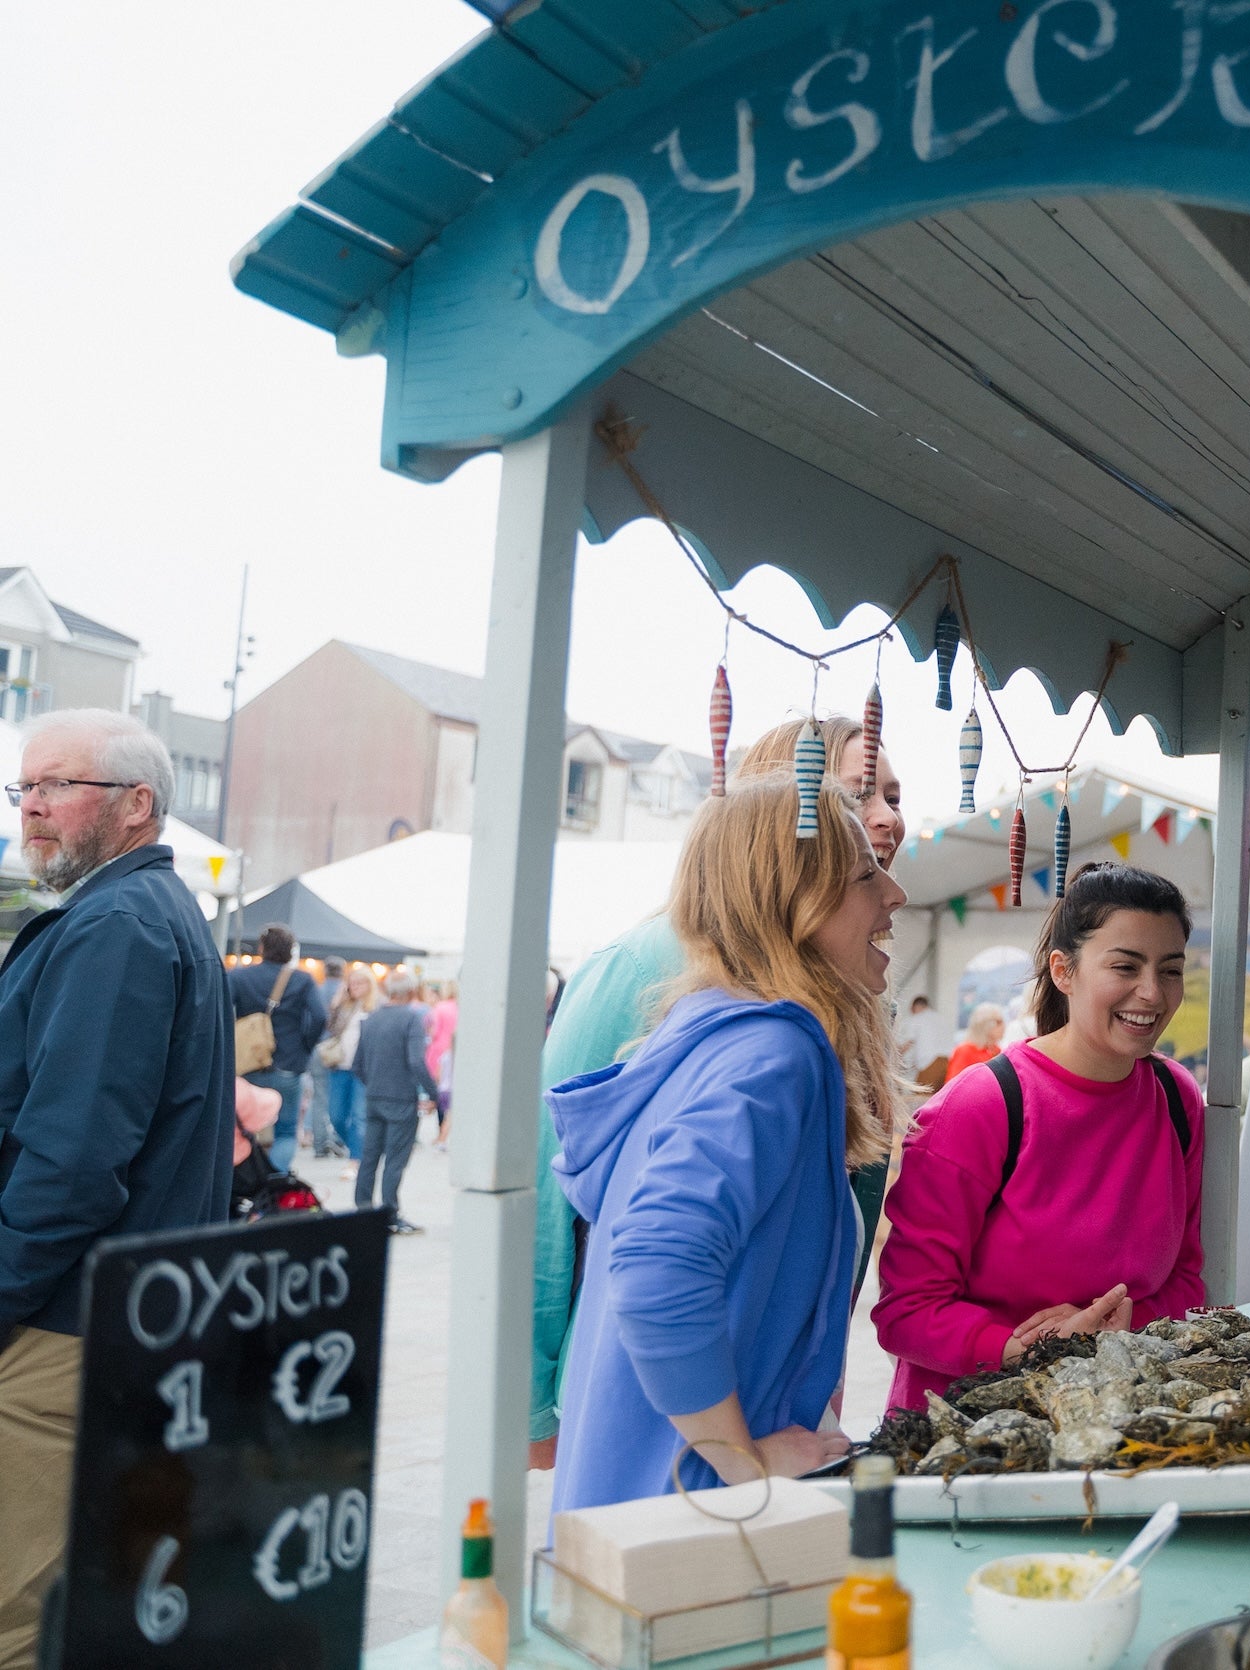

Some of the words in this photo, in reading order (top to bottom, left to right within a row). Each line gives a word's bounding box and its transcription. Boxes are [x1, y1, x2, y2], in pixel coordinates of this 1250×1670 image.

[156, 1359, 210, 1453] 1
[271, 1329, 357, 1424] €2
[134, 1535, 190, 1645] 6
[252, 1487, 369, 1602] €10
